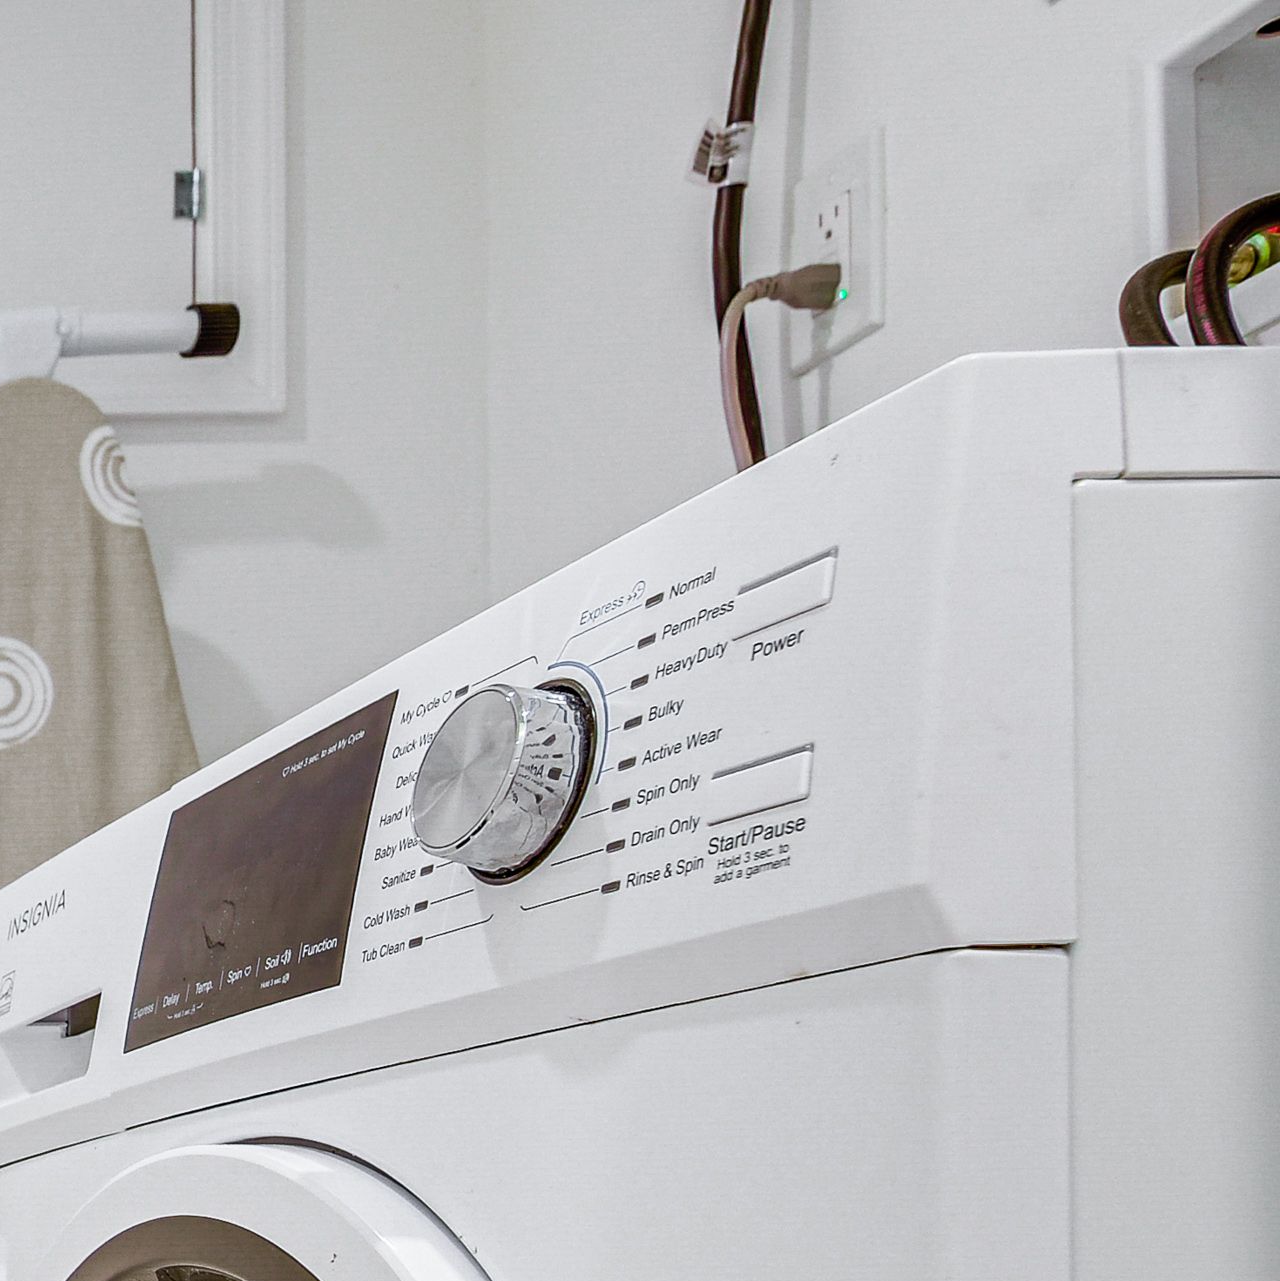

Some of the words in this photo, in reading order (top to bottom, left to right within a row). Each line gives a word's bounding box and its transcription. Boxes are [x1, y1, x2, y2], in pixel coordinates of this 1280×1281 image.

[669, 566, 717, 599] Normal
[579, 595, 625, 626] Express
[750, 629, 805, 662] Power
[400, 709, 415, 725] My
[416, 696, 441, 718] Cycle
[648, 699, 684, 722] Bulky
[392, 738, 418, 759] Quick
[641, 741, 682, 766] Active
[686, 728, 723, 750] Wear
[636, 785, 665, 806] Spin
[669, 774, 701, 794] Only
[379, 808, 403, 827] Hand
[631, 825, 665, 847] Drain
[669, 815, 701, 835] Only
[707, 817, 806, 855] Start/Pause
[374, 844, 397, 861] Baby
[717, 854, 741, 870] Hold
[743, 851, 751, 863] 3
[779, 844, 790, 854] to
[381, 868, 416, 890] Sanitize
[626, 869, 661, 889] Rinse
[663, 862, 672, 879] &
[676, 855, 704, 877] Spin
[713, 869, 734, 884] add
[735, 869, 743, 879] a
[745, 856, 791, 879] garment
[7, 888, 66, 942] INSIGNIA
[363, 910, 385, 930] Cold
[385, 904, 411, 923] Wash
[302, 937, 338, 959] Function
[361, 946, 378, 964] Tub
[379, 940, 406, 959] Clean
[264, 954, 280, 971] Soil
[226, 968, 243, 985] Spin
